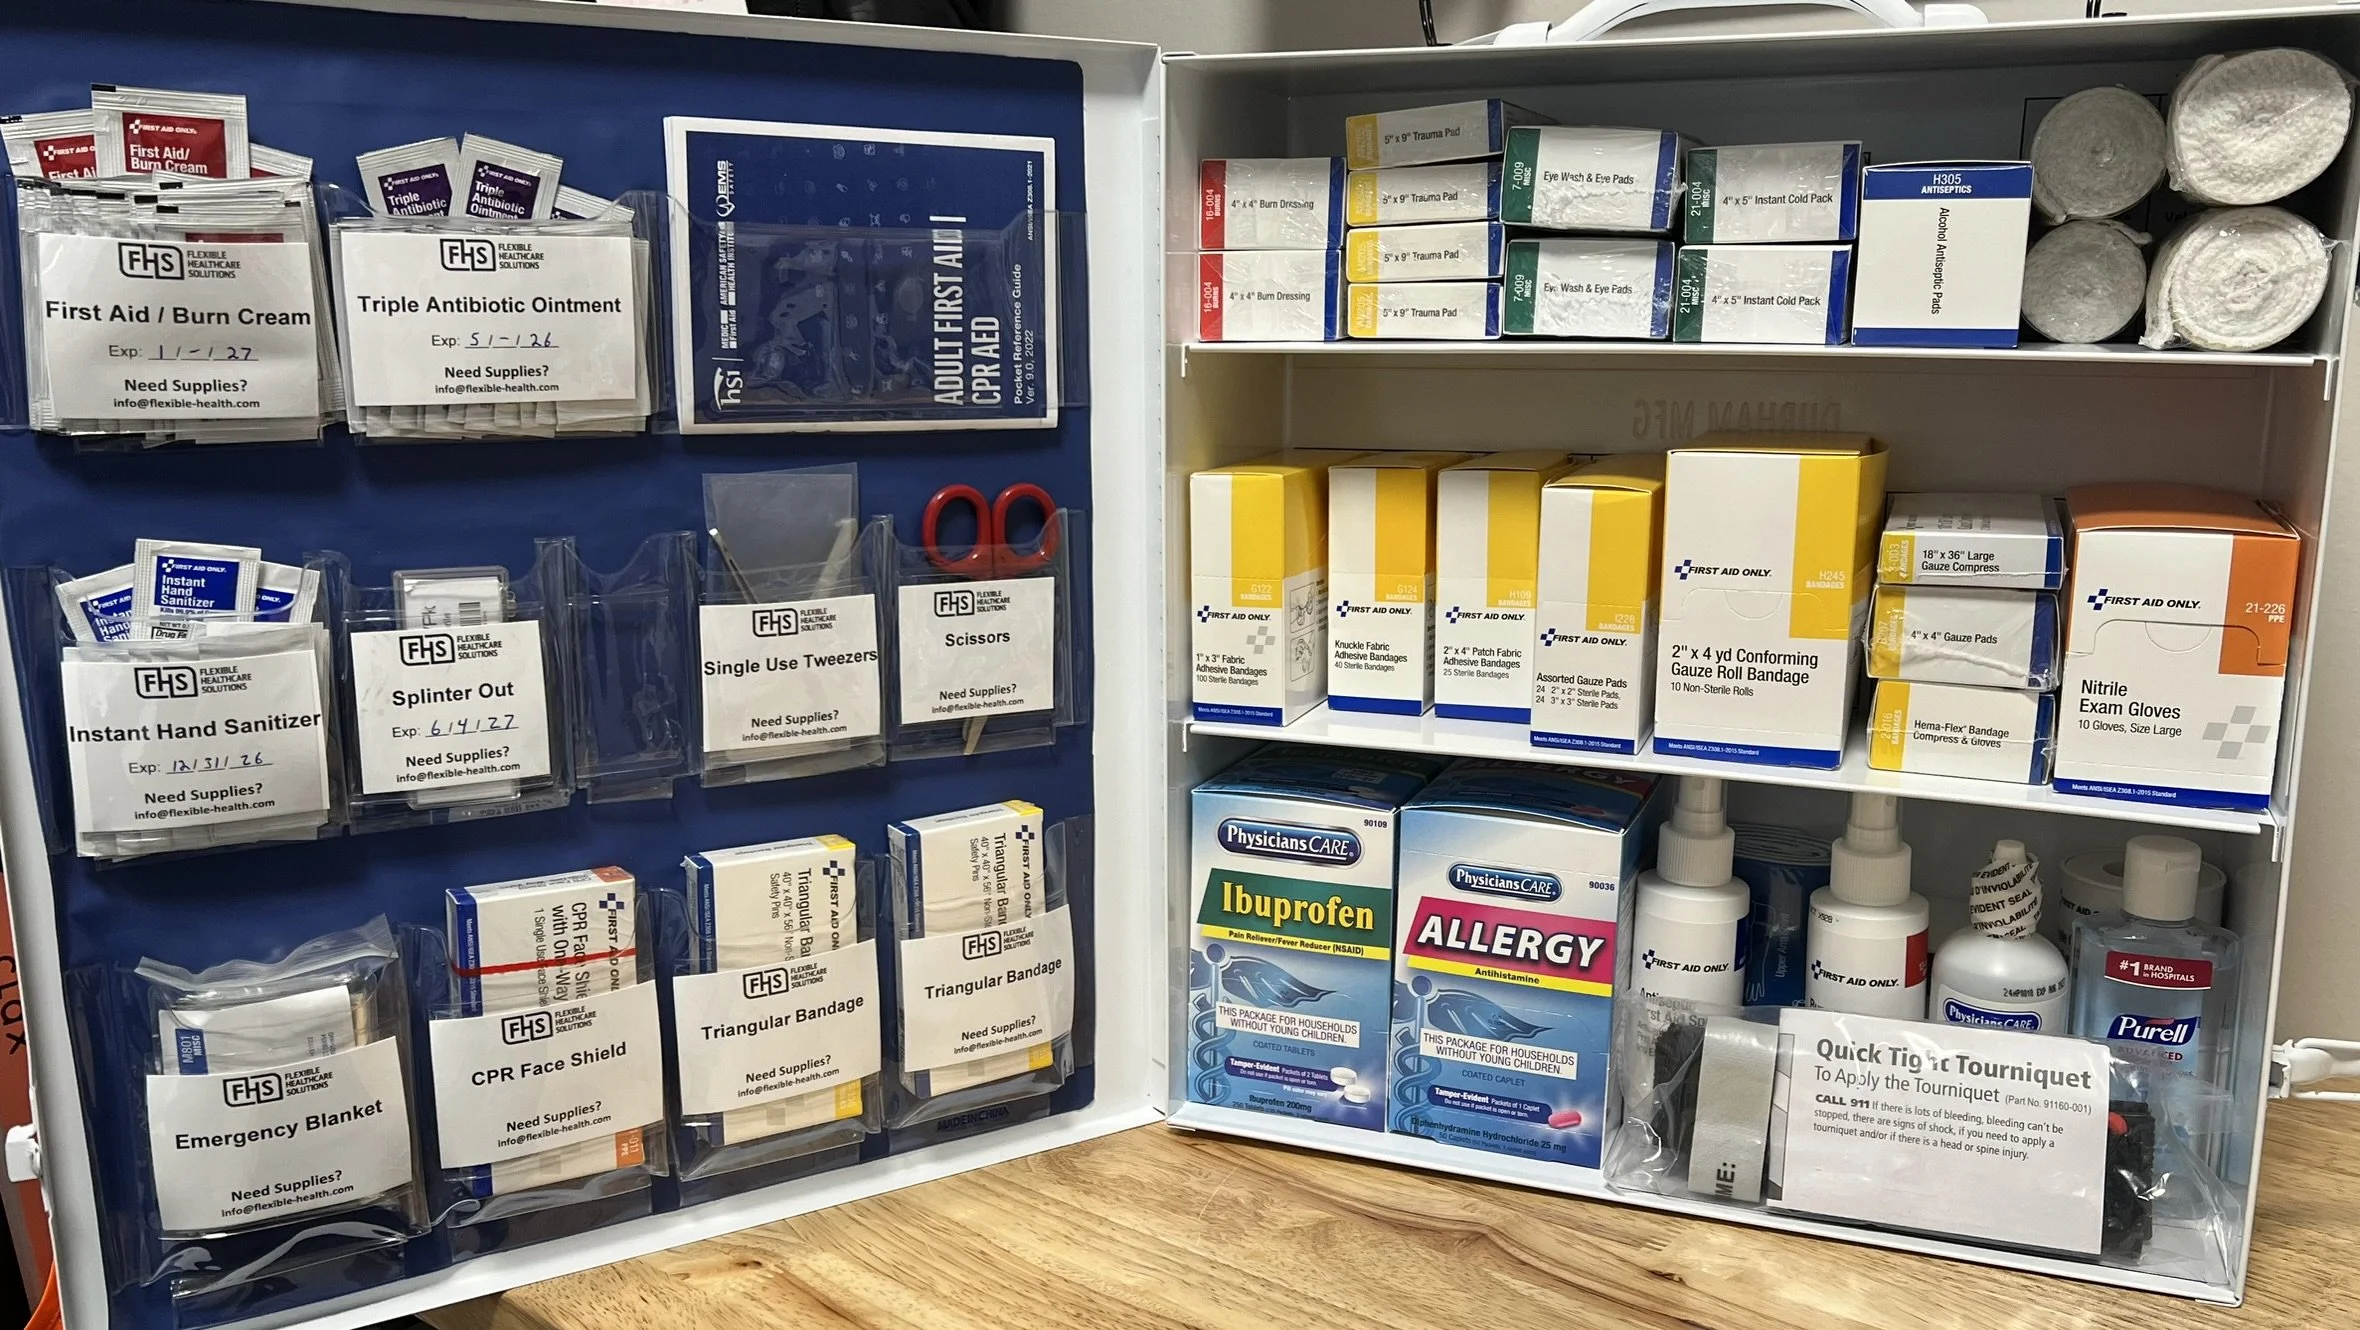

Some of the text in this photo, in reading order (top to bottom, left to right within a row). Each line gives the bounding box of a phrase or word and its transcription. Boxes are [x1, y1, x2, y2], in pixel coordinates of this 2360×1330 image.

[130, 144, 190, 160] First Aid/
[131, 159, 208, 174] Burn Cream
[717, 160, 727, 194] EMS
[1512, 162, 1524, 190] 7-009
[1523, 168, 1531, 185] MISC
[1544, 171, 1558, 182] Eye
[1562, 172, 1584, 182] Wash
[1596, 174, 1610, 183] Eye
[1613, 174, 1634, 184] Pads
[1934, 174, 1961, 184] H305
[1701, 189, 1710, 207] MISC
[1921, 185, 1971, 194] ANTISEPTICS
[1206, 189, 1214, 221] 16-004
[1691, 182, 1702, 216] 21-004
[1755, 195, 1786, 204] Instant
[1788, 194, 1808, 204] Cold
[1806, 193, 1833, 205] Pack
[187, 250, 227, 259] FLEXIBLE
[1932, 208, 1950, 314] Alcohol Antiseptic Pads
[188, 260, 240, 269] HEALTHCARE
[188, 270, 236, 278] SOLUTIONS
[1258, 292, 1274, 300] Burn
[1277, 292, 1310, 302] Dressing
[46, 301, 102, 321] First
[110, 305, 149, 322] Aid
[173, 307, 229, 324] Burn
[238, 308, 310, 325] Cream
[358, 296, 621, 316] Triple Antibiotic Ointment
[934, 273, 964, 405] ADULT FIRST
[1012, 264, 1022, 404] Pocket Reference Guide
[109, 345, 142, 359] Exp:
[971, 317, 1001, 404] CPR AED
[1025, 330, 1034, 404] Ver. 9.0, 2022
[125, 378, 248, 395] Need Supplies?
[436, 383, 559, 394] info@flexible-health.com
[114, 398, 260, 409] info@flexible-health.com
[1968, 551, 1994, 562] Large
[1688, 566, 1719, 574] FIRST
[1922, 561, 2000, 573] Gauze Compress
[1820, 571, 1845, 581] H245
[2246, 603, 2285, 614] 21-226
[946, 632, 1010, 646] Scissors
[1335, 640, 1390, 651] Knuckle Fabric
[704, 648, 878, 677] Single Use Tweezers
[1335, 650, 1407, 664] Adhesive Bandages
[1703, 647, 1711, 660] 4
[1716, 648, 1732, 664] yd
[1737, 649, 1818, 669] Conforming
[1537, 673, 1627, 688] Assorted Gauze Pads
[1672, 662, 1809, 686] Gauze Roll Bandage
[393, 682, 514, 708] Splinter Out
[1671, 682, 1753, 696] 10 Non-Sterile Rolls
[2082, 680, 2127, 696] Nitrile
[2080, 698, 2180, 719] Exam Gloves
[70, 714, 320, 742] Instant Hand Sanitizer
[392, 727, 420, 738] Exp:
[2079, 720, 2182, 738] 10 Gloves, Size Large
[129, 763, 160, 775] Exp:
[1364, 819, 1387, 828] 90109
[794, 868, 812, 932] Triangular
[1222, 881, 1374, 930] Ibuprofen
[2008, 889, 2032, 905] SEAL
[1229, 931, 1364, 956] Pain Reliever/Fever Reducer (NSAID)
[1417, 915, 1604, 967] ALLERGY
[1475, 968, 1540, 984] Antihistamine
[2120, 960, 2140, 976] #1
[2144, 964, 2173, 972] BRAND
[2151, 972, 2194, 982] HOSPITALS
[701, 997, 863, 1040] Triangular Bandage
[1219, 1006, 1357, 1033] THIS PACKAGE FOR HOUSEHOLDS
[1230, 1018, 1347, 1043] WITHOUT YOUNG CHILDREN.
[2118, 1016, 2188, 1043] Purell
[183, 1035, 193, 1063] M801
[472, 1042, 626, 1085] CPR Face Shield
[1816, 1038, 1881, 1064] Quick
[1956, 1055, 2091, 1090] Tourniquet
[1815, 1066, 1831, 1081] To
[1885, 1074, 1909, 1091] the
[1914, 1078, 1999, 1102] Tourniquet
[2005, 1095, 2092, 1115] (Part No. 91160-001)
[1816, 1094, 1846, 1106] CALL
[1851, 1098, 1870, 1108] 911
[1880, 1102, 1903, 1113] there
[1905, 1105, 1912, 1114] is
[1915, 1106, 1930, 1116] lots
[1933, 1107, 1942, 1117] of
[1945, 1109, 1984, 1126] bleeding,
[1986, 1115, 2024, 1131] bleeding
[2052, 1124, 2063, 1134] be
[176, 1100, 382, 1149] Emergency Blanket
